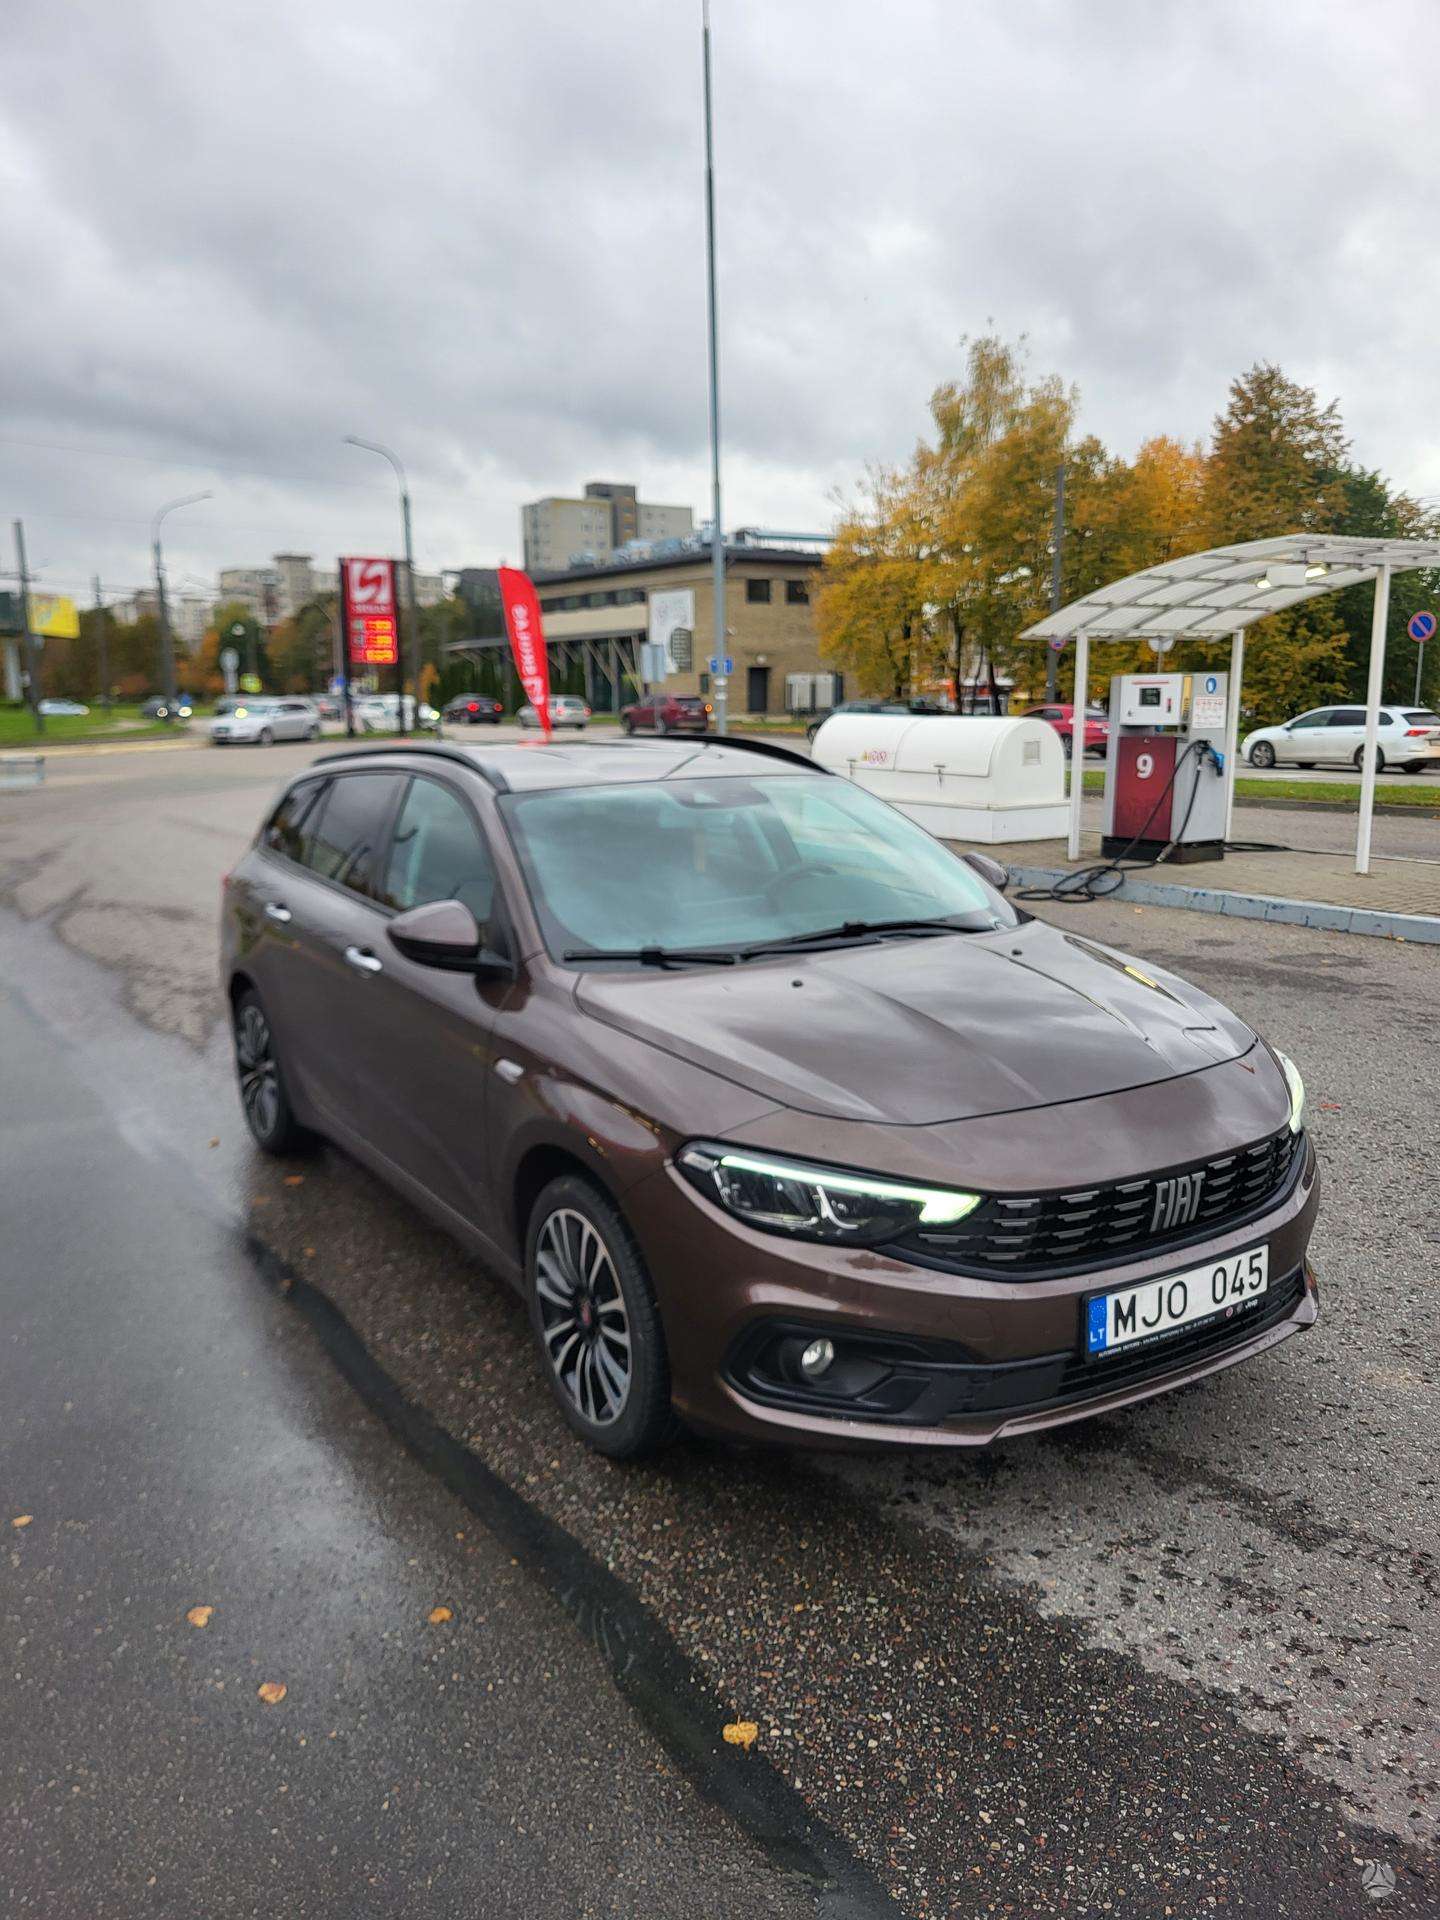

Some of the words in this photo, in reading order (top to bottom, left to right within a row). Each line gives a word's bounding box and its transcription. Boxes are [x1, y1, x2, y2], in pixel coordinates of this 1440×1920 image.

[1136, 753, 1154, 779] 9
[1150, 1171, 1206, 1232] FIAT
[1113, 1280, 1188, 1338] MJO
[1211, 1252, 1263, 1305] 045
[1089, 1328, 1106, 1343] LT
